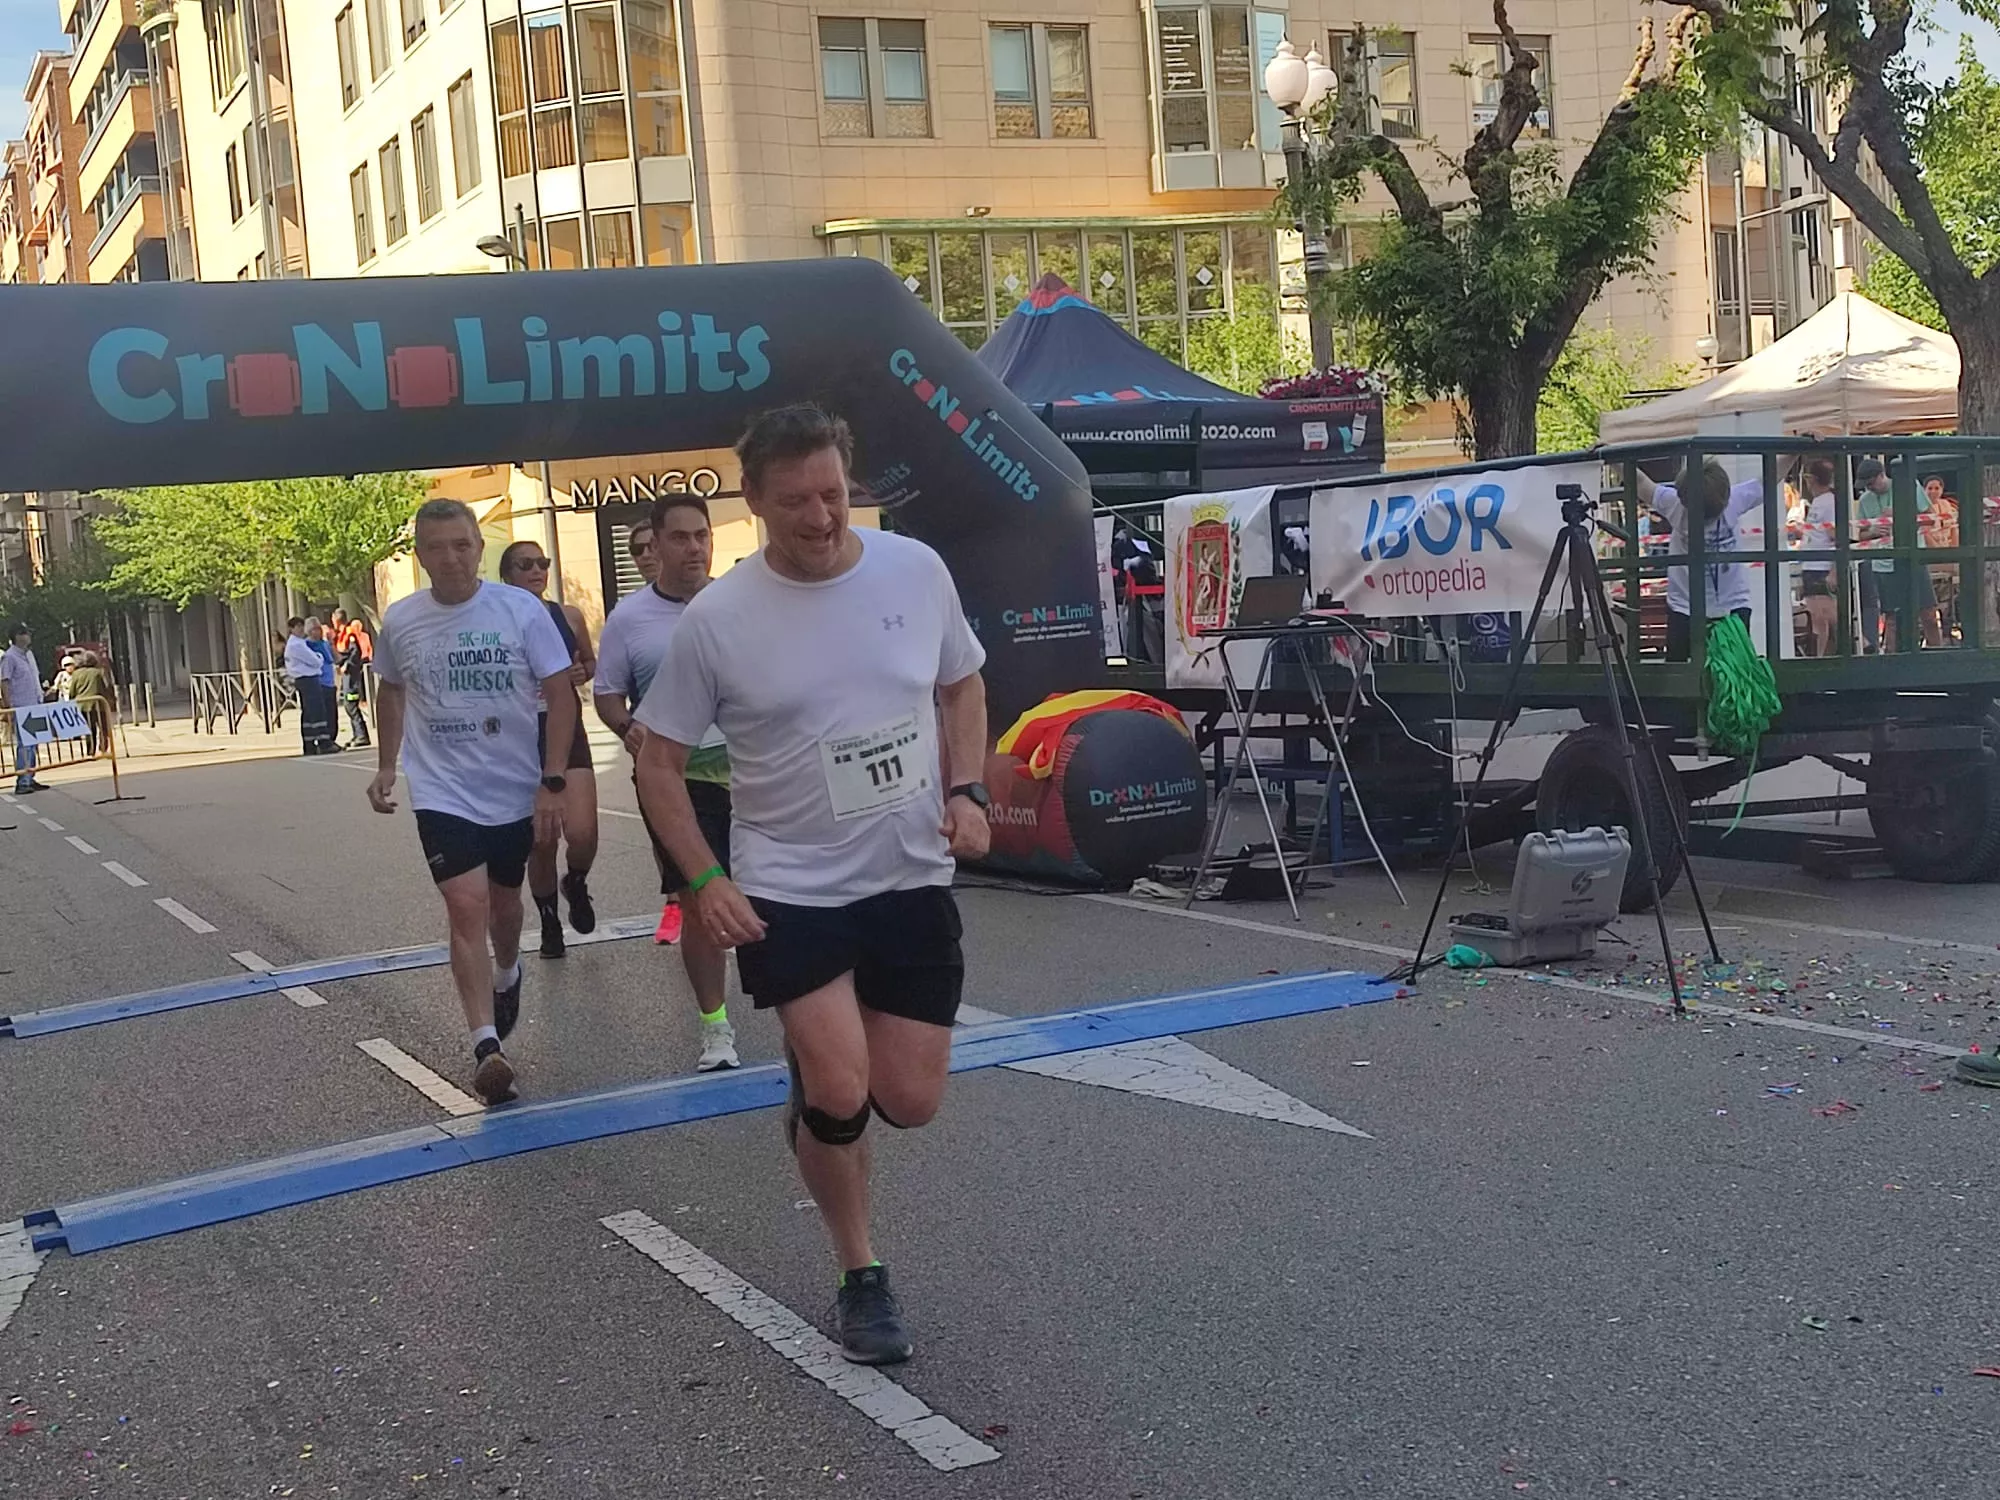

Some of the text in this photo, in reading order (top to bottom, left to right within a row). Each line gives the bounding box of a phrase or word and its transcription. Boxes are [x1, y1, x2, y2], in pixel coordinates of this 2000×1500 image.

[570, 468, 720, 508] MANGO
[1360, 484, 1513, 561] IBOR
[1382, 558, 1486, 602] ortopedia
[448, 647, 510, 668] CIUDAD DE
[448, 669, 514, 692] HUESCA
[52, 706, 86, 729] 10K
[864, 755, 904, 787] 111
